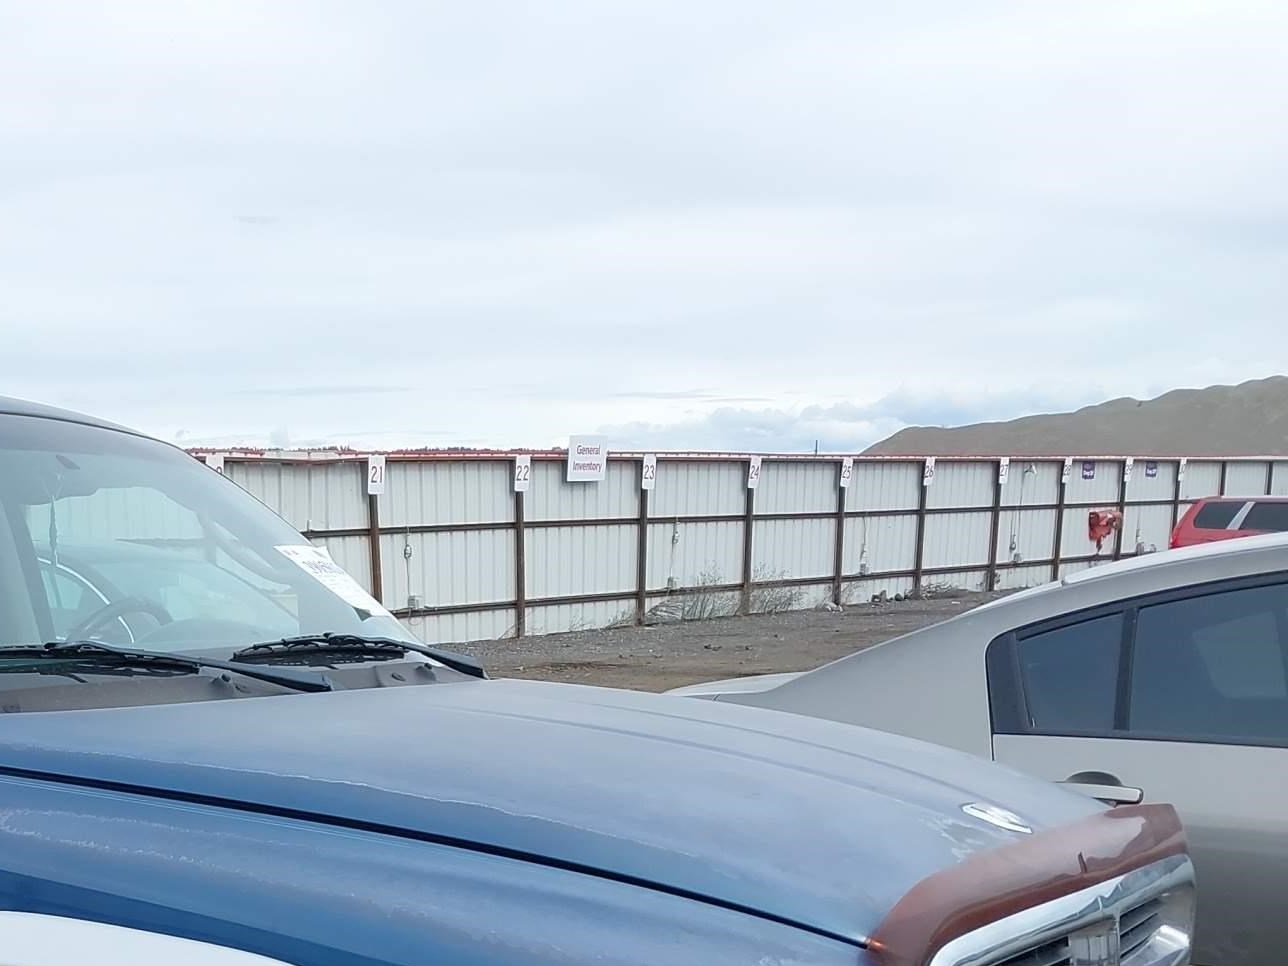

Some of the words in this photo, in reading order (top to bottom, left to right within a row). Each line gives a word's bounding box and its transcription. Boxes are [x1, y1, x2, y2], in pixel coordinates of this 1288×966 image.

[576, 444, 601, 456] General
[370, 465, 383, 484] 21
[516, 465, 530, 481] 22
[572, 461, 602, 473] Inventory
[643, 464, 655, 480] 23
[750, 465, 760, 480] 24
[841, 464, 852, 479] 25
[924, 464, 934, 478] 26
[999, 464, 1009, 477] 27
